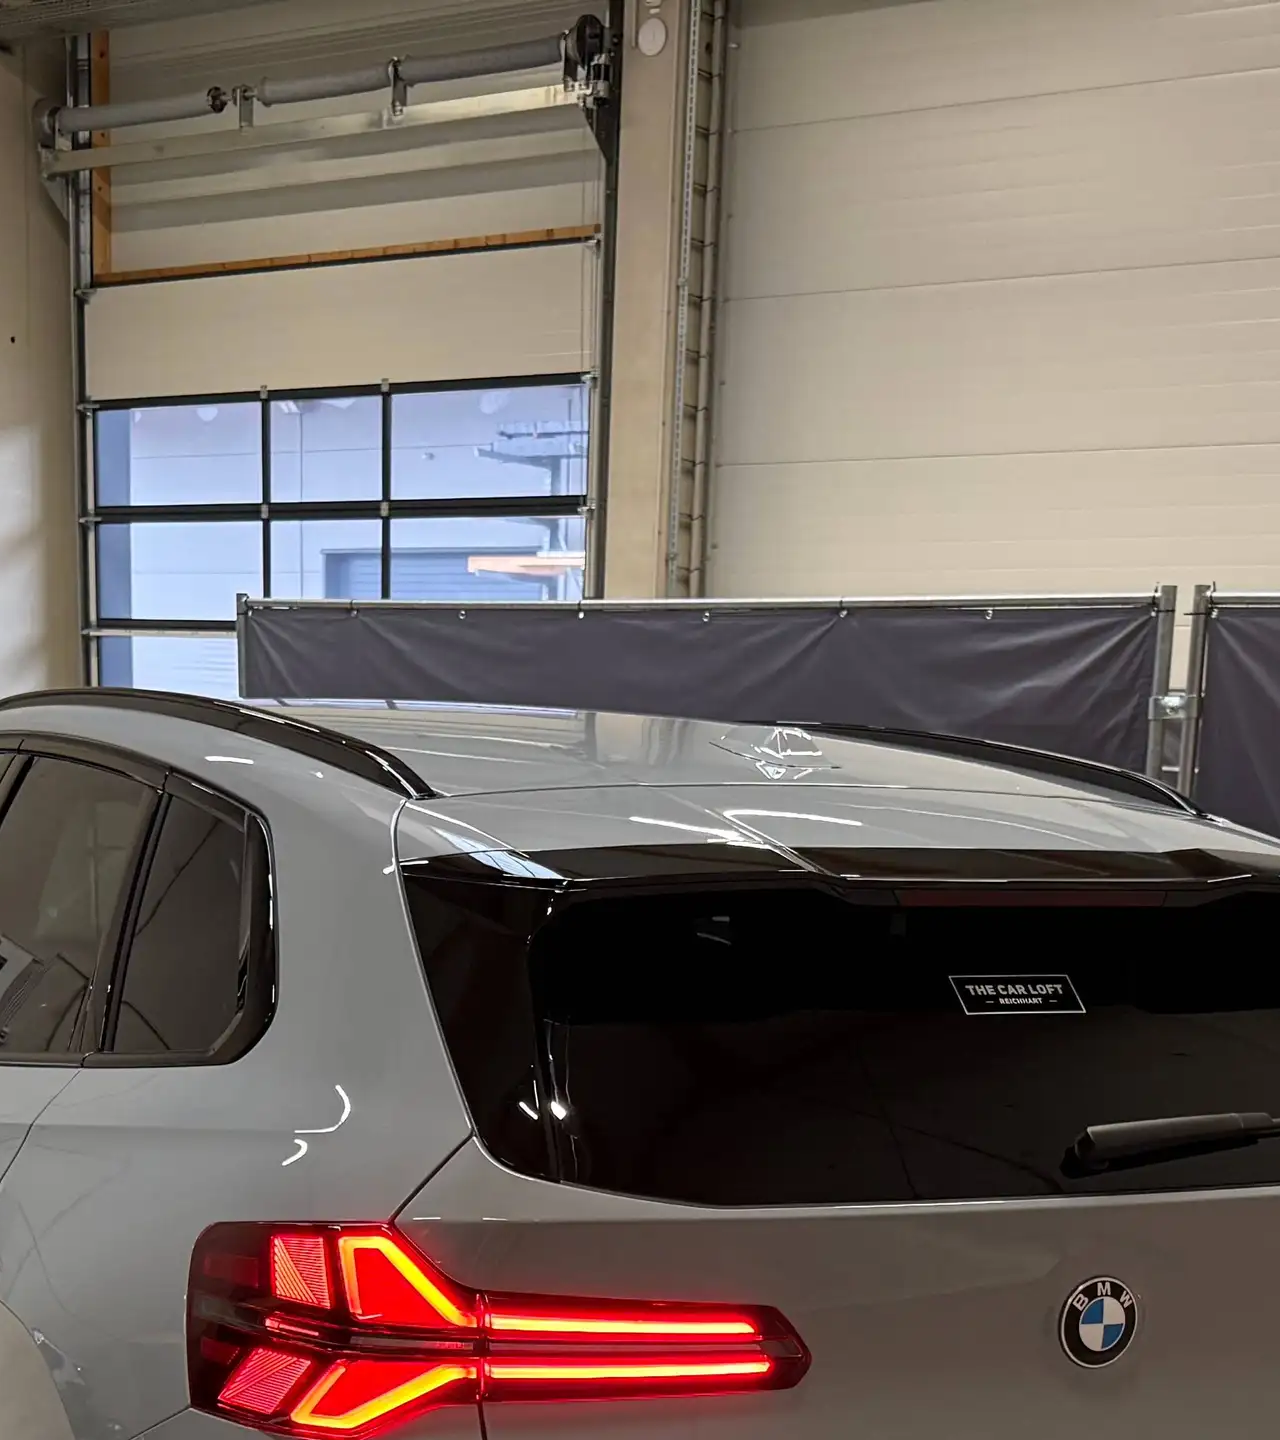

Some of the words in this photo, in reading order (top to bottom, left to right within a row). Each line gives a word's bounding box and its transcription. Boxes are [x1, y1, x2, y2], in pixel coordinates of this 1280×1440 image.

[964, 984, 996, 996] THE
[997, 984, 1027, 995] CAR
[1029, 983, 1063, 995] LOFT
[1072, 1281, 1133, 1312] BMW
